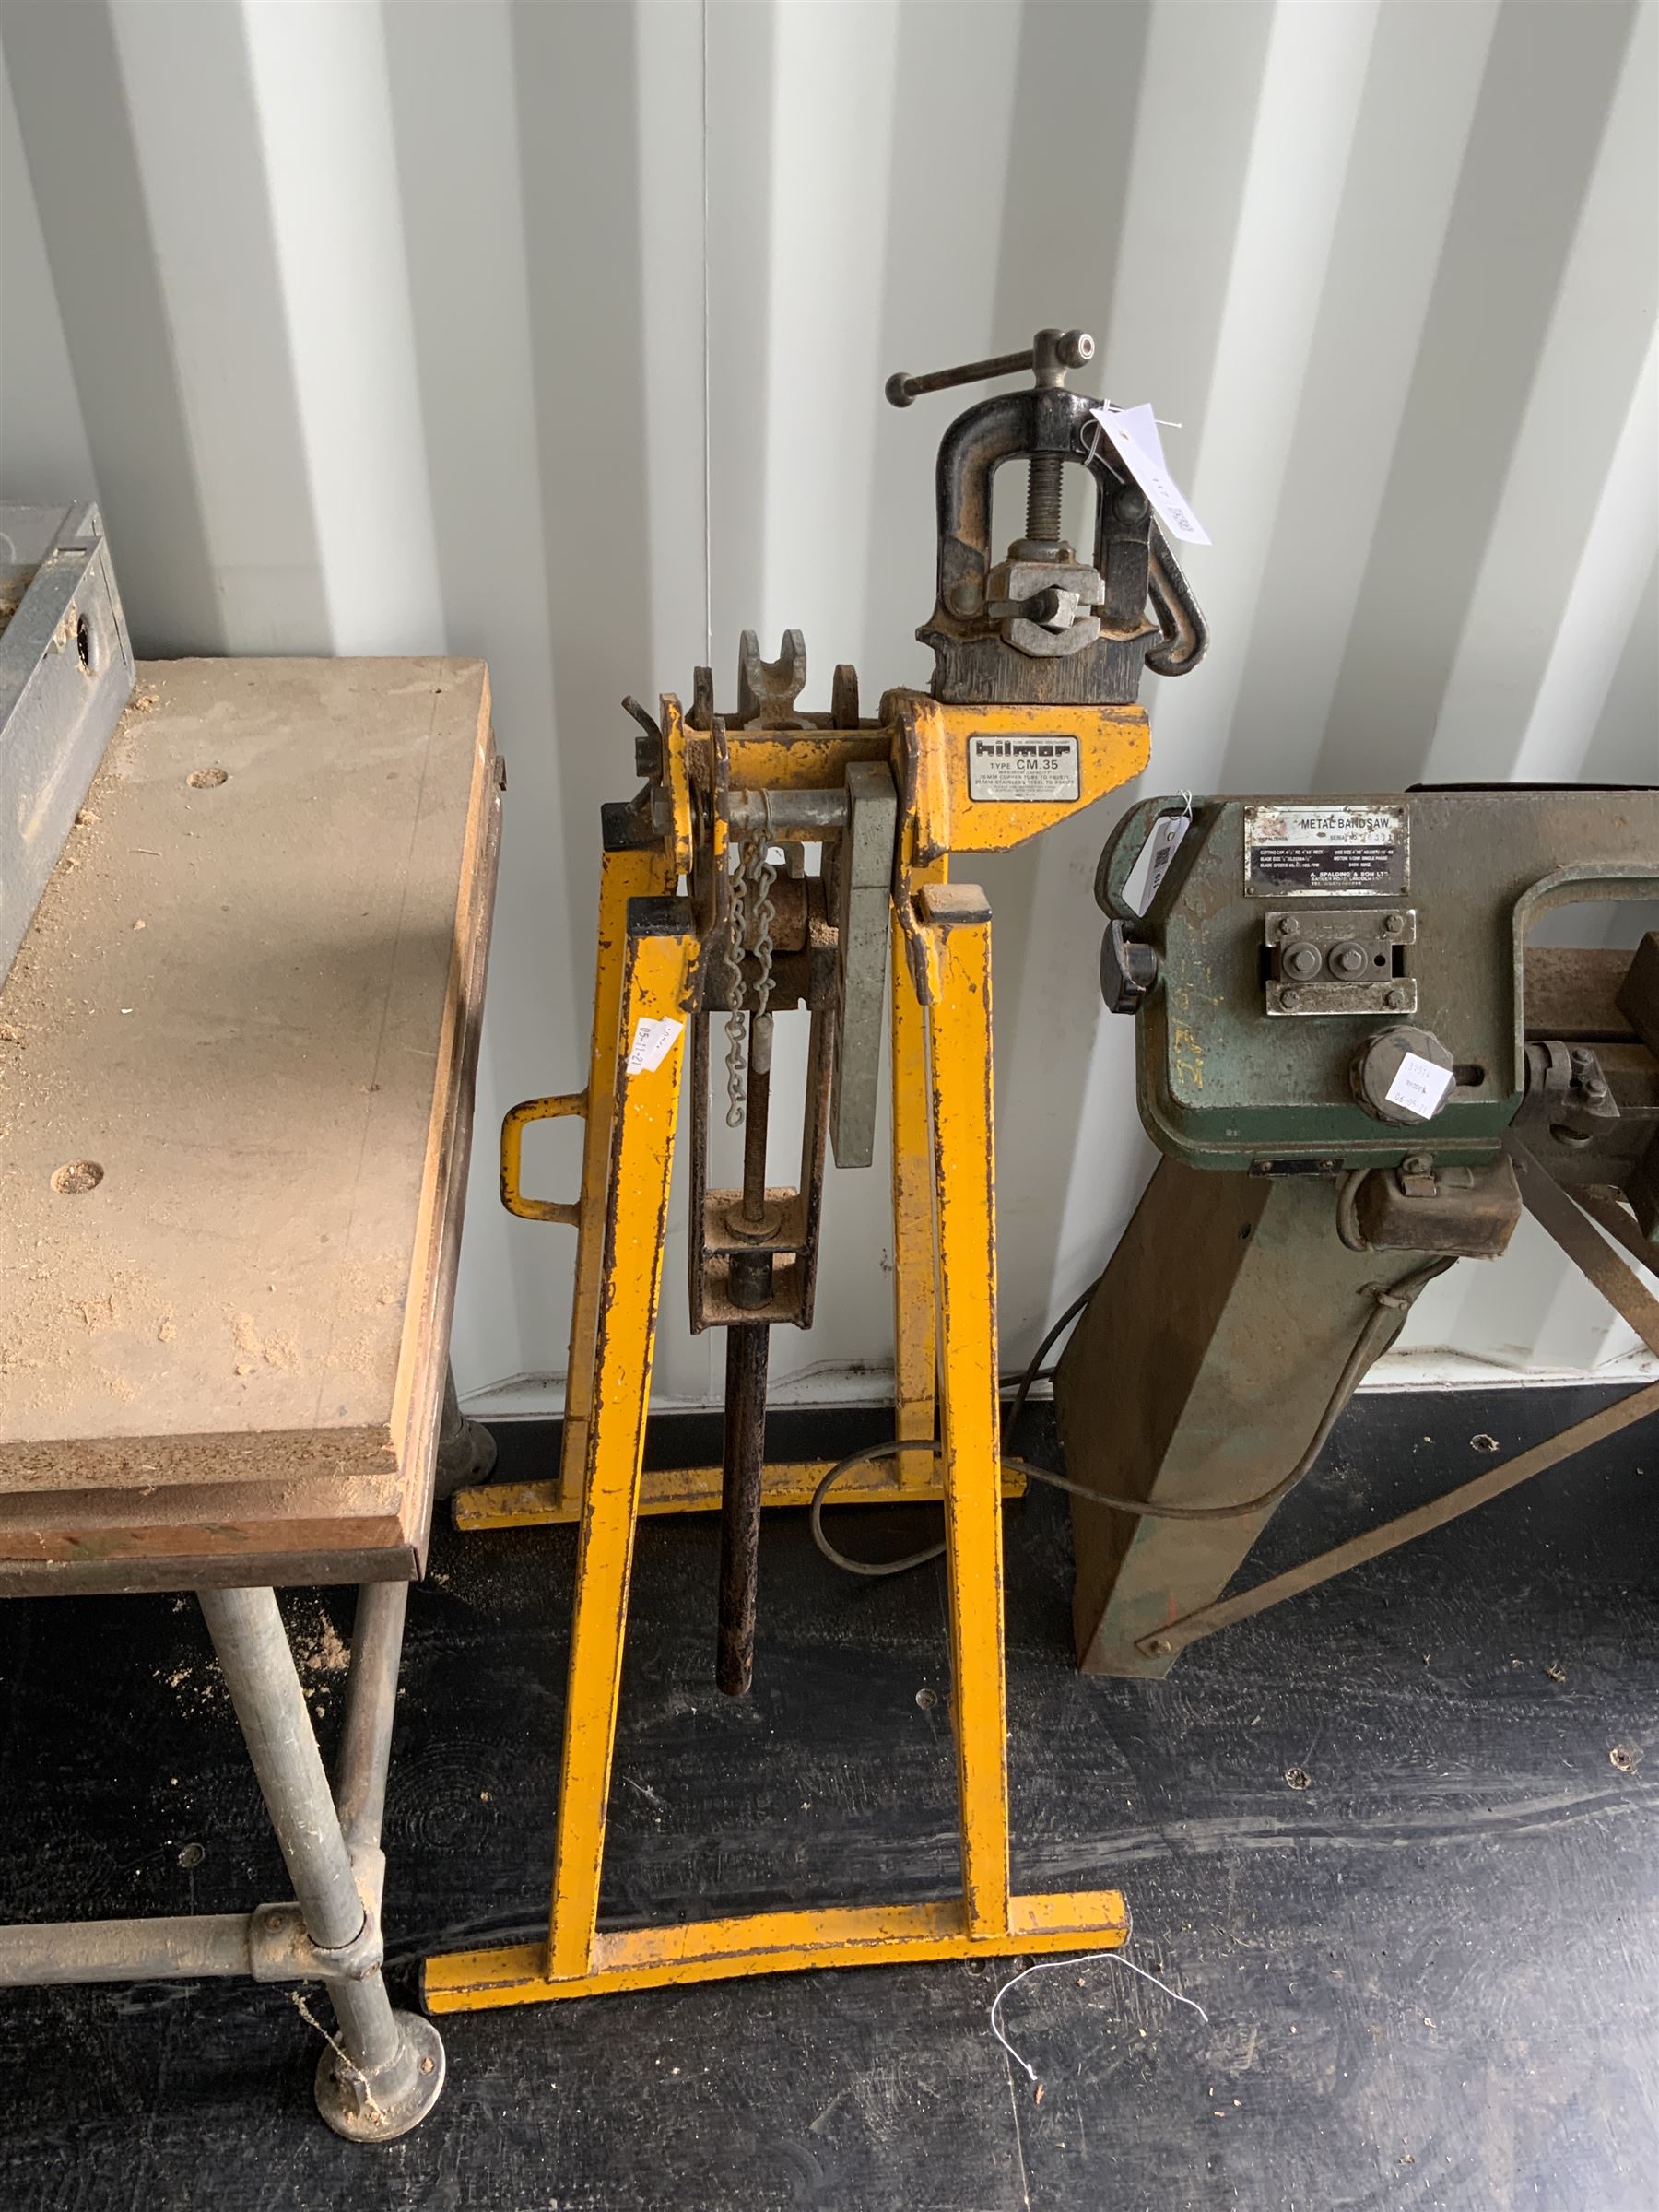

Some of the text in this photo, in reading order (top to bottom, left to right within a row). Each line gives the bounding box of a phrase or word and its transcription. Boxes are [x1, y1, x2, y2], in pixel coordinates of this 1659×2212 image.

[976, 740, 1071, 757] hilmor
[1017, 759, 1059, 771] CM.35
[1301, 818, 1390, 829] METAL BANDSAW
[630, 1026, 652, 1065] 05-11-21
